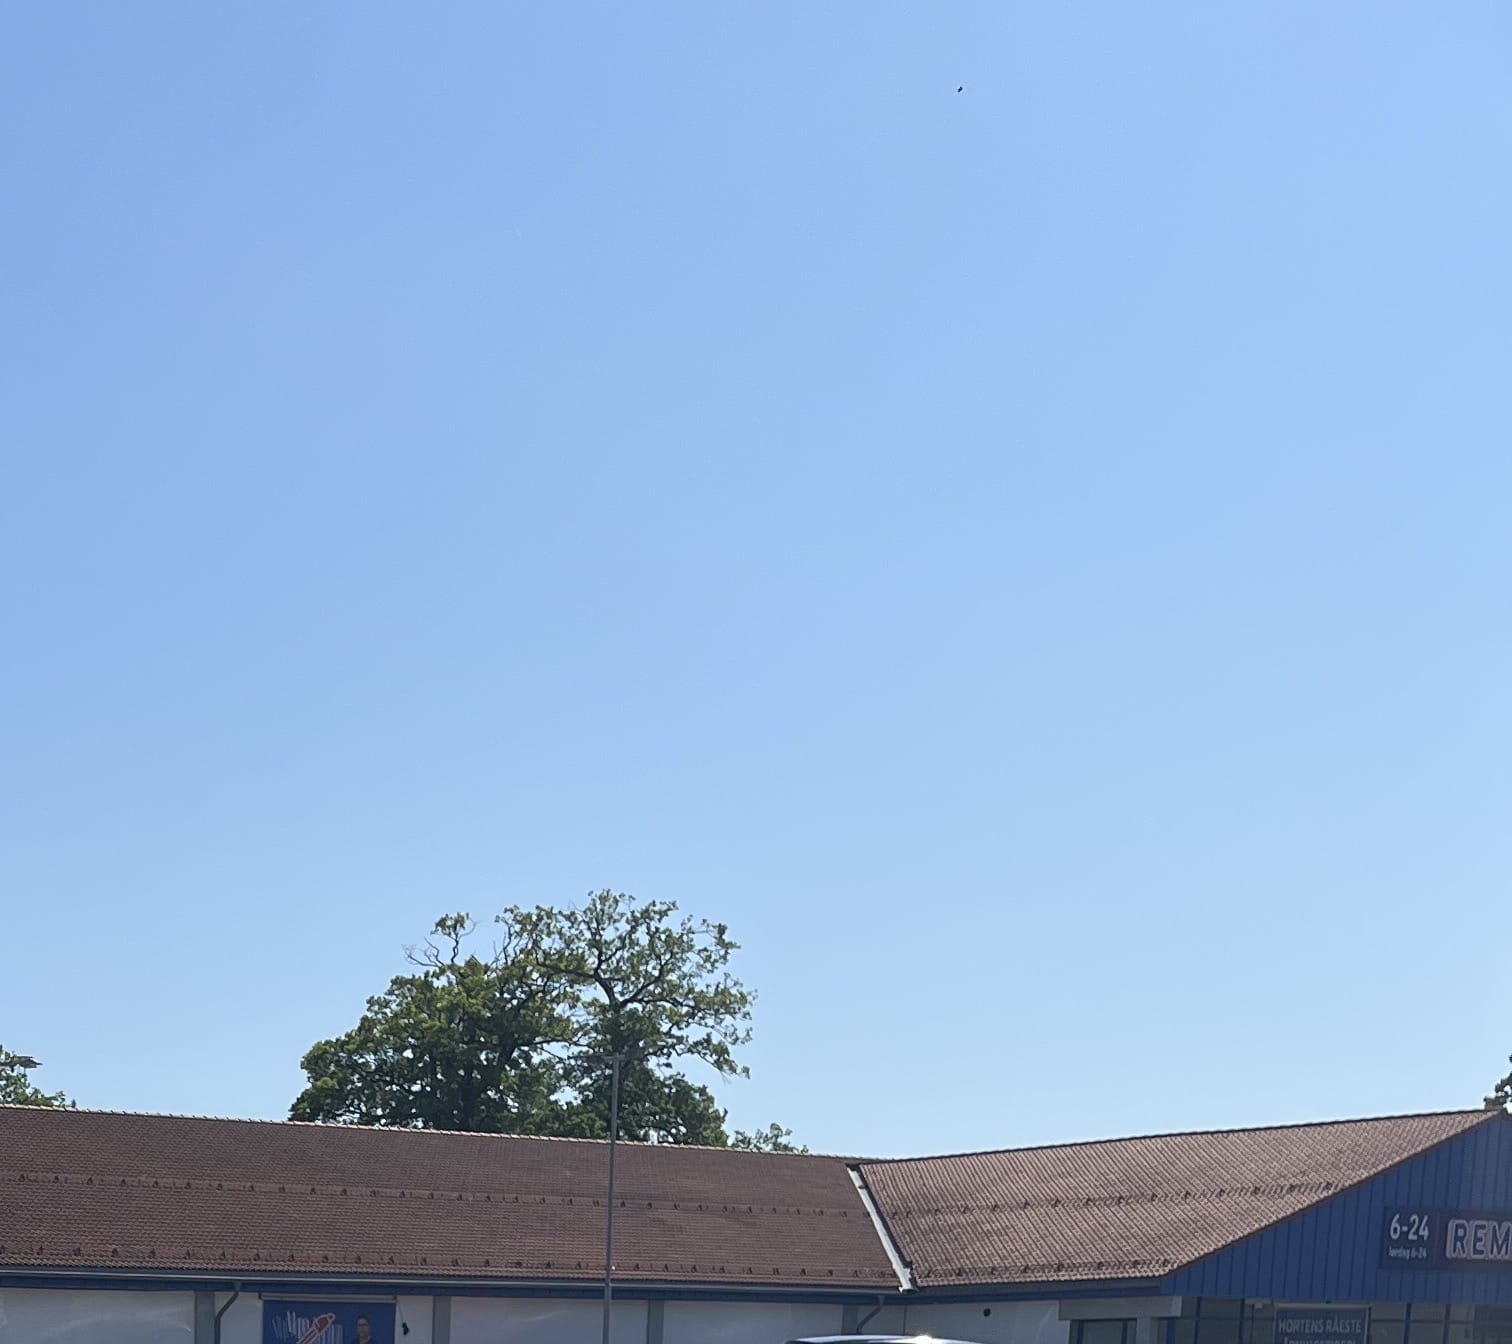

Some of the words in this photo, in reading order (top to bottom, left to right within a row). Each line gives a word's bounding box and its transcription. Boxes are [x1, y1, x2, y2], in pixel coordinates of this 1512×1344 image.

[1389, 1213, 1430, 1241] 6-24
[1278, 1319, 1325, 1334] HORTENS
[1325, 1316, 1362, 1334] RÅESTE
